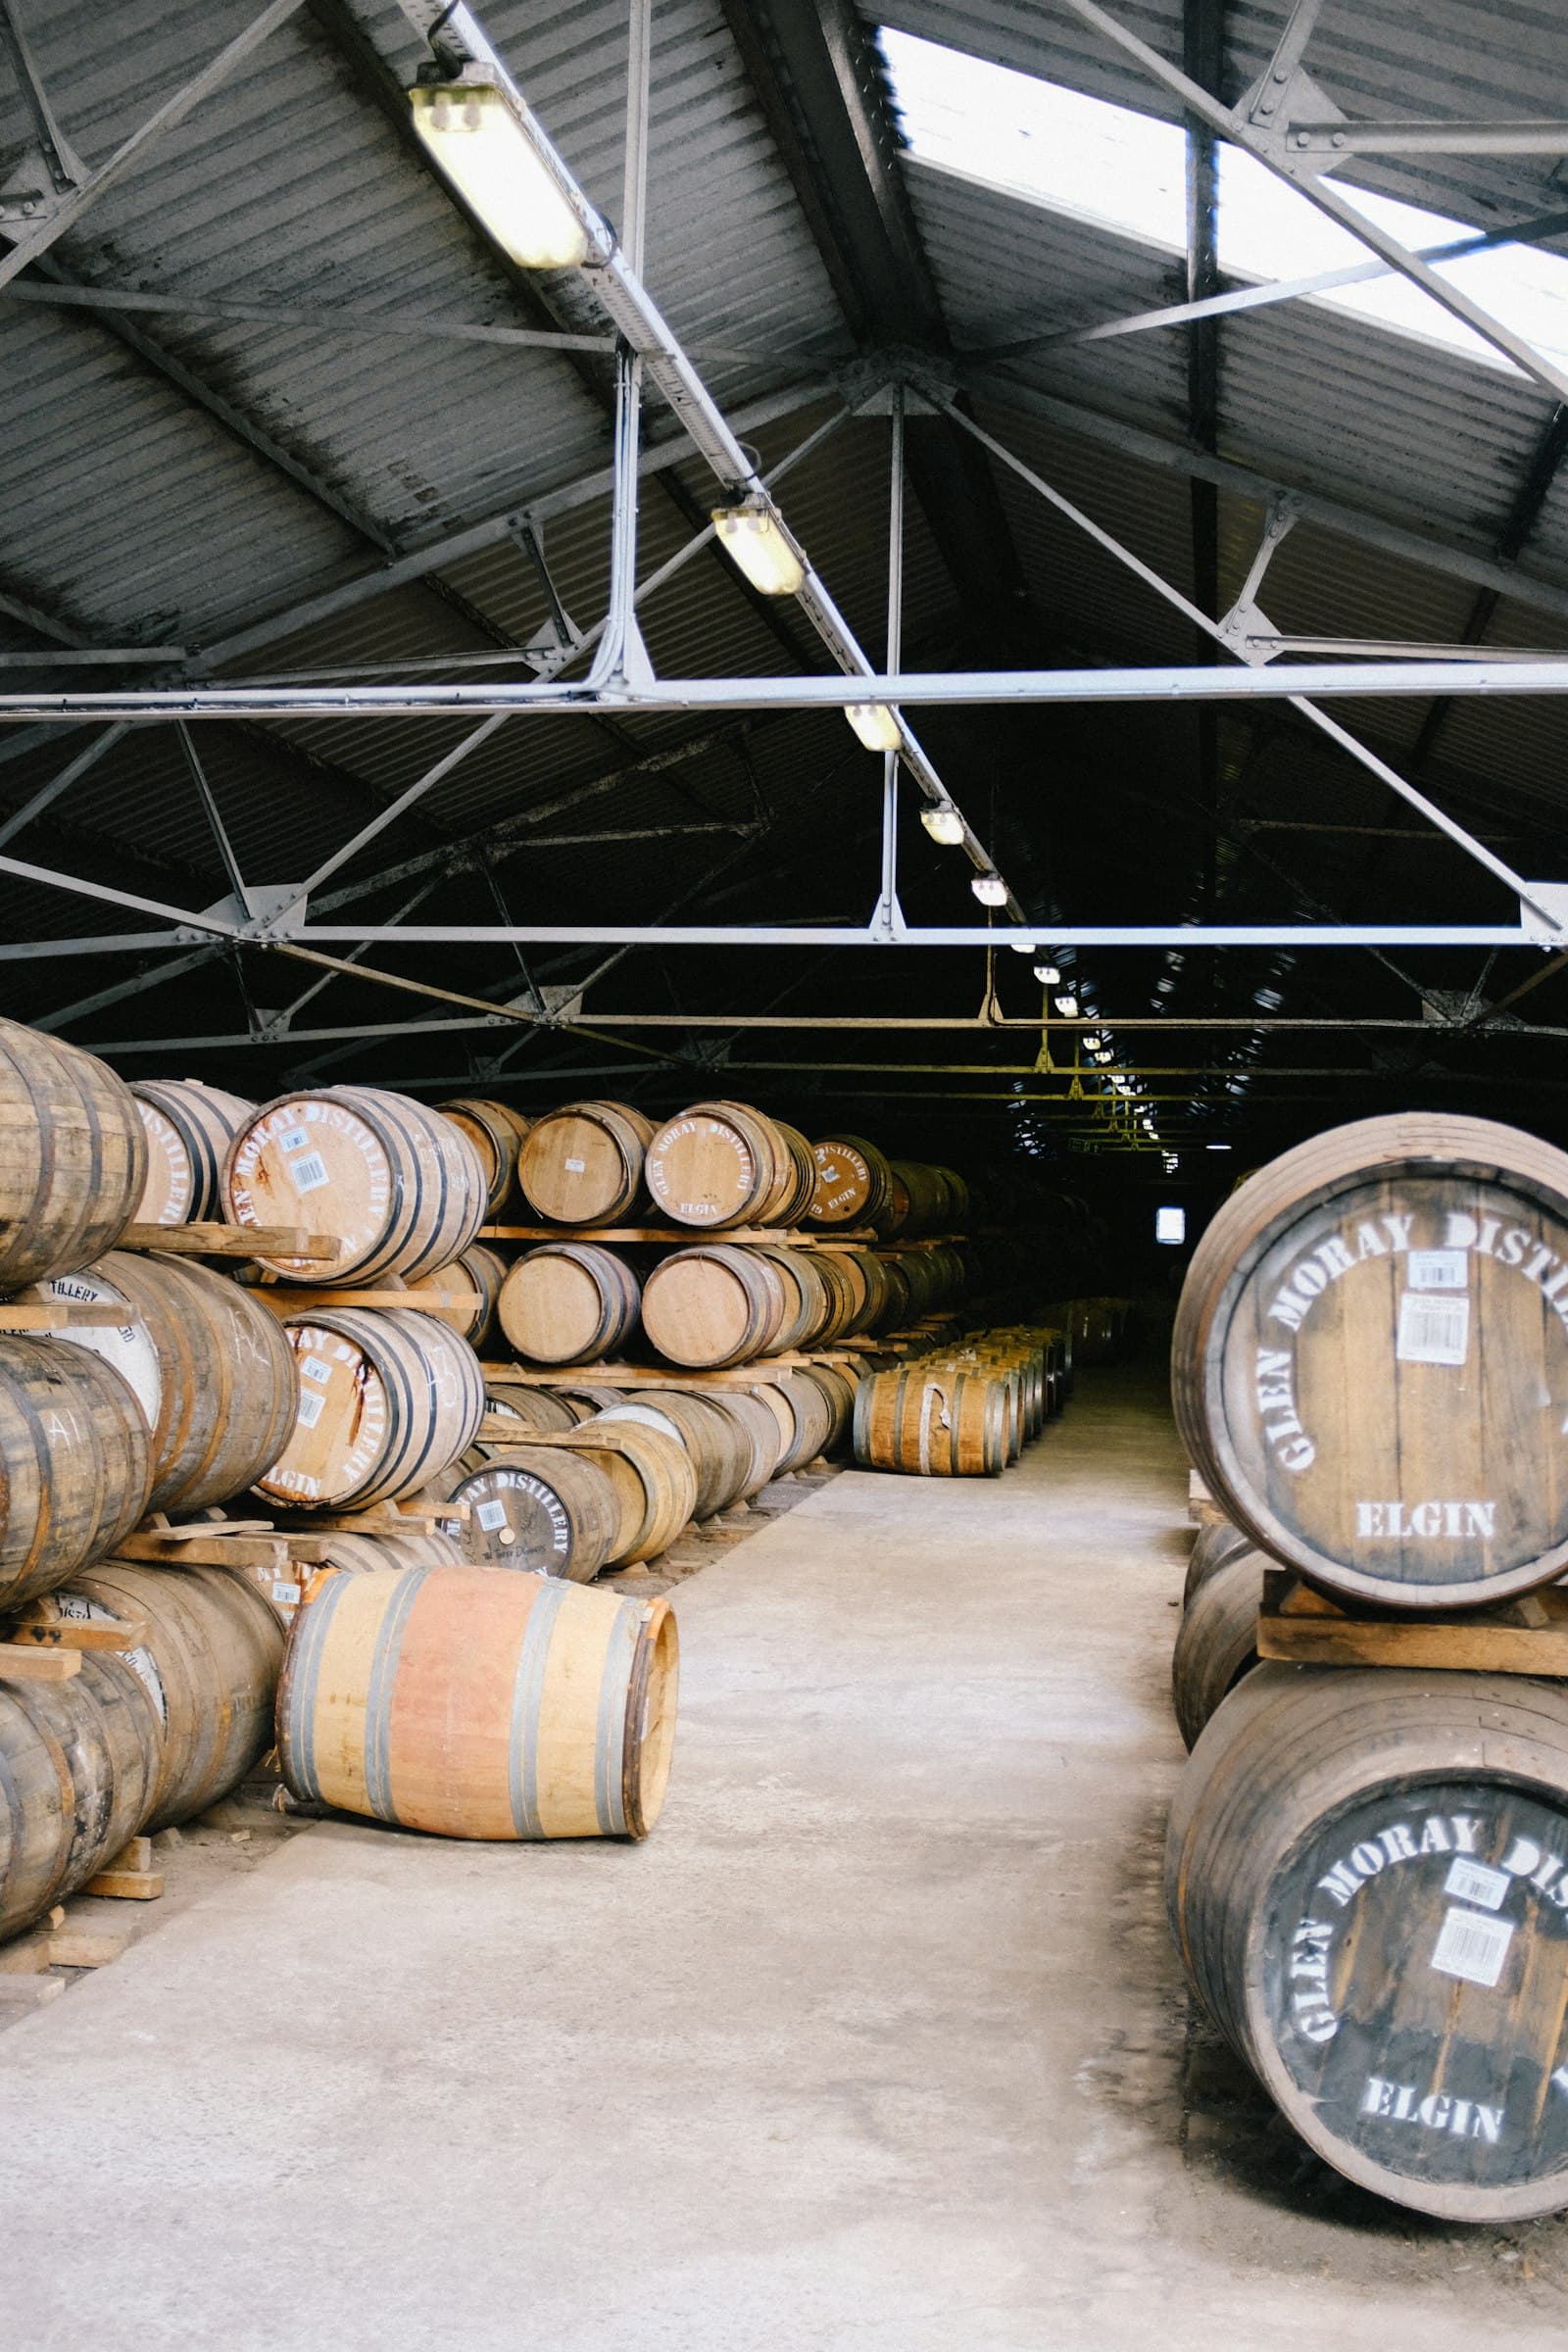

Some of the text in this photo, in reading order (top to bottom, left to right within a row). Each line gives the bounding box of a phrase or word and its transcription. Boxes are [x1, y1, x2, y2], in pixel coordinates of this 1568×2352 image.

[235, 1107, 295, 1178] MORAY
[305, 1103, 388, 1217] DISTILLERY
[680, 1201, 717, 1215] ELGIN
[826, 1187, 857, 1210] ELGIN
[1267, 1212, 1415, 1333] MORAY
[49, 1407, 82, 1454] A1
[1256, 1348, 1316, 1471] GLEN
[496, 1472, 568, 1554] DISTILLERY
[1356, 1500, 1496, 1538] ELGIN
[1290, 1917, 1341, 2043] GLEN
[1316, 1815, 1484, 1908] MORAY
[1362, 2076, 1505, 2144] ELGIN
